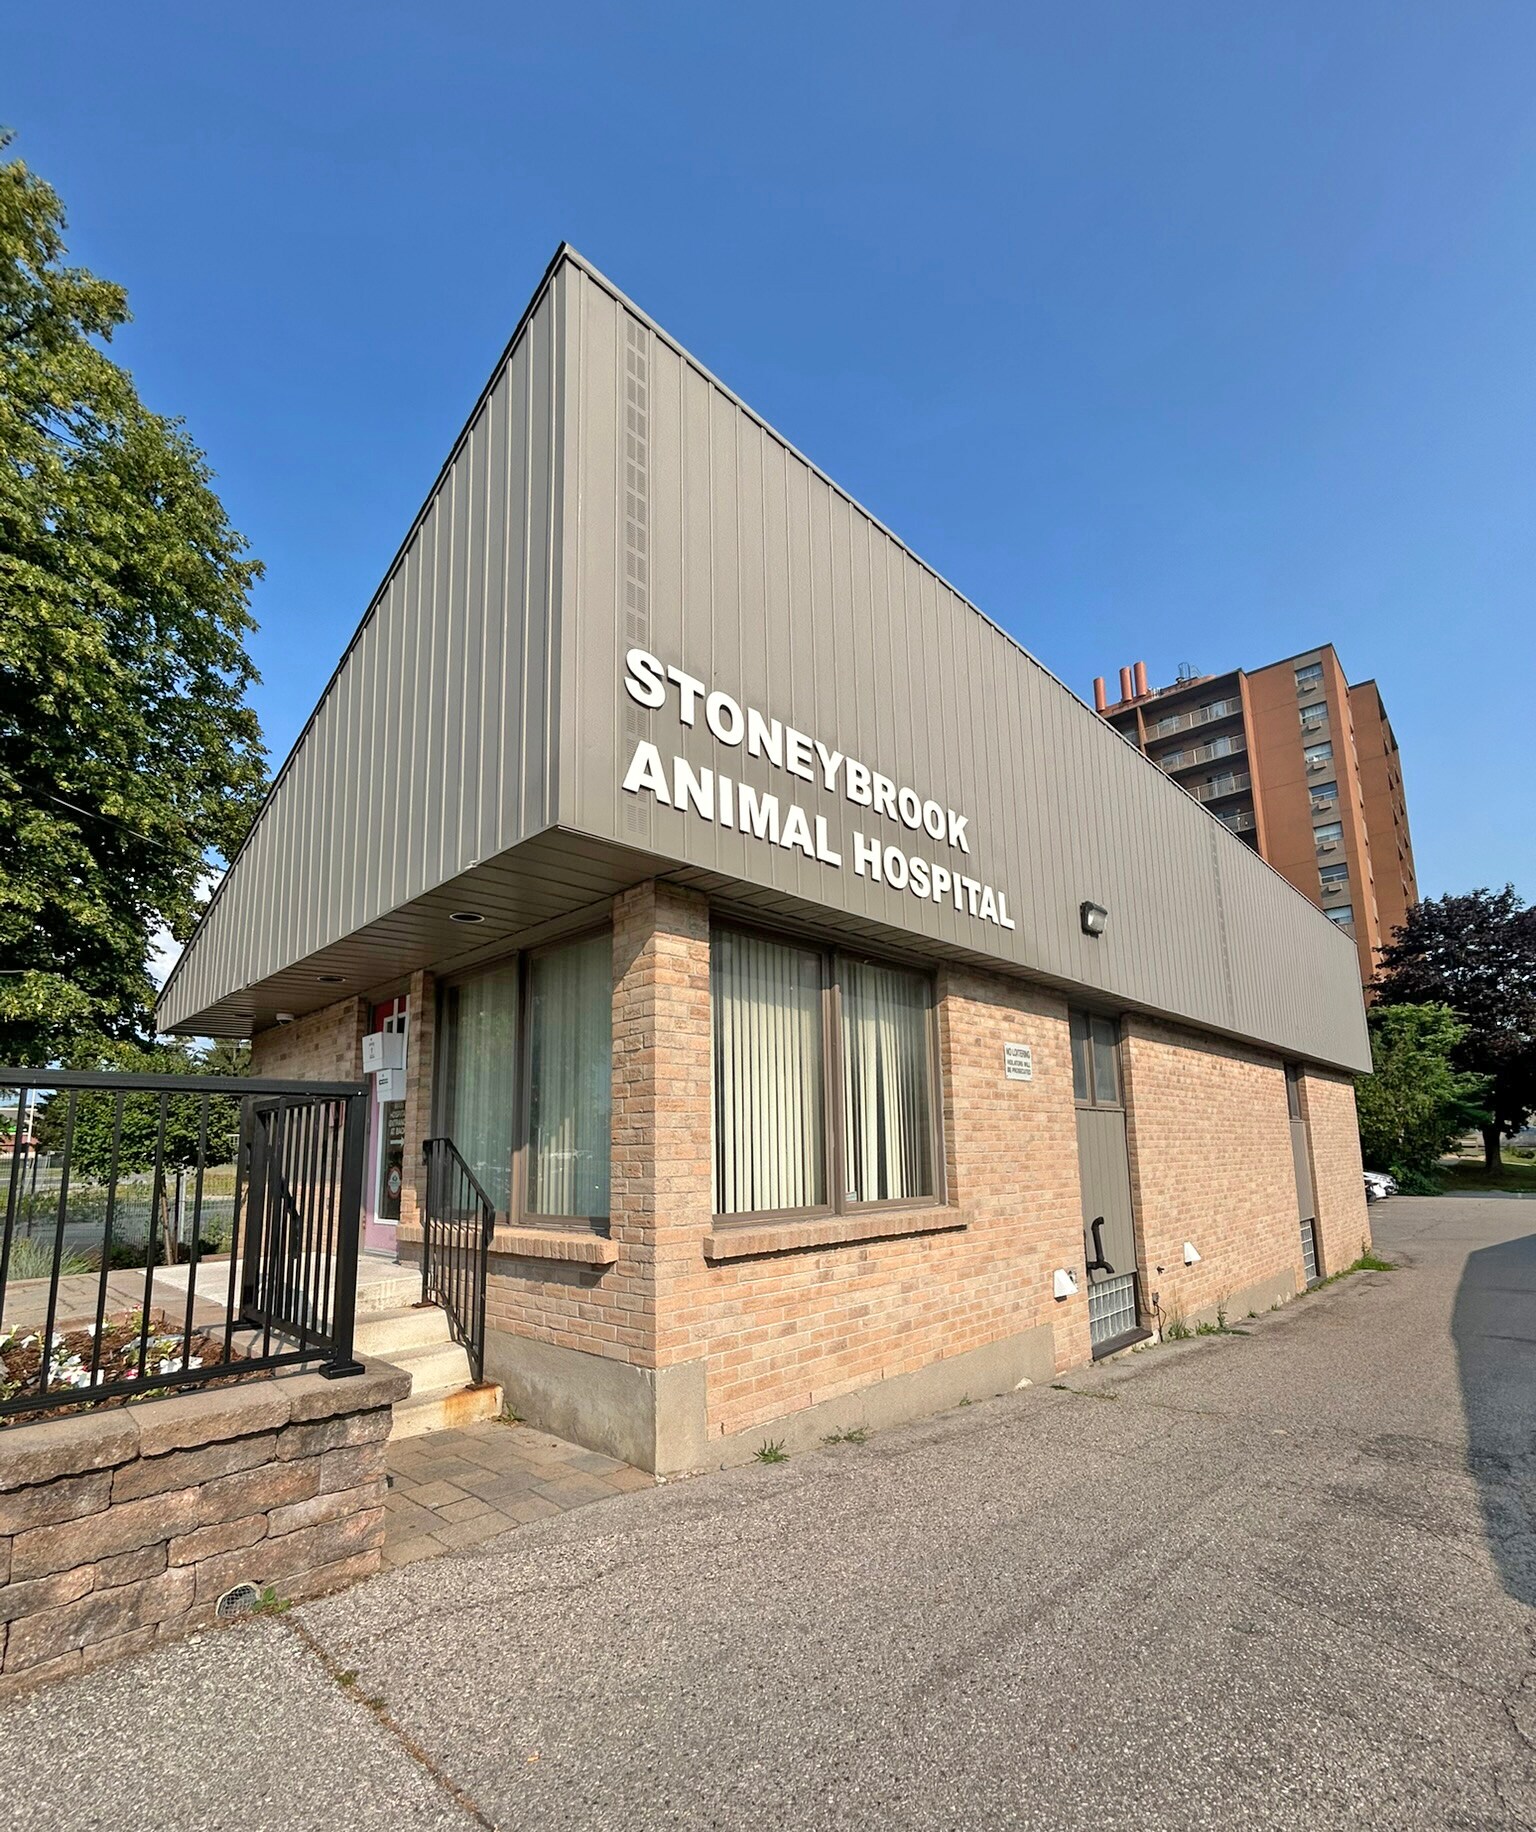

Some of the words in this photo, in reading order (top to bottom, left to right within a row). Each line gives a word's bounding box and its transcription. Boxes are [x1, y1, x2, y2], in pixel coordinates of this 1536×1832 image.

[622, 740, 842, 867] ANIMAL
[853, 830, 1016, 930] HOSPITAL
[624, 648, 971, 854] STONEYBROOK
